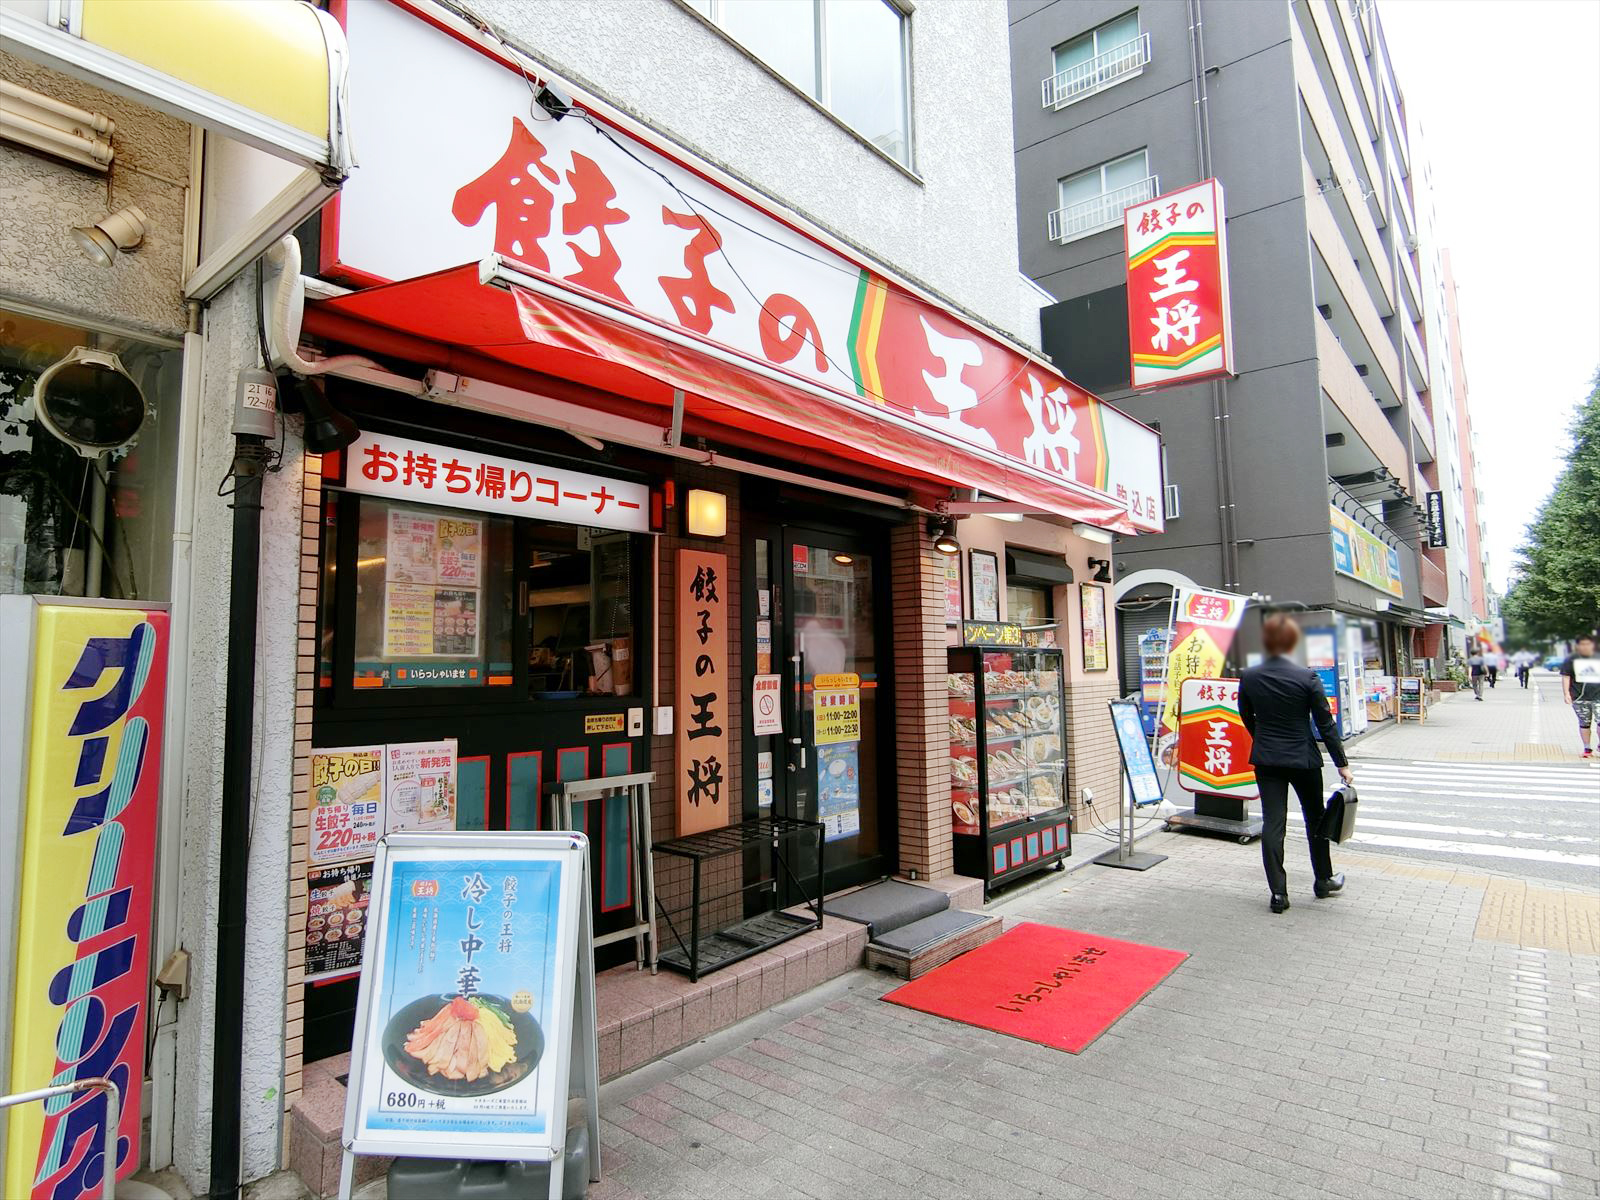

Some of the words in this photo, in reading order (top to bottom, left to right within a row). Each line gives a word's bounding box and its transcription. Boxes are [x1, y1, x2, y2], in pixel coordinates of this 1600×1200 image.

[1136, 202, 1205, 236] 餃子の
[452, 116, 829, 374] 餃子の
[912, 314, 1081, 481] 王将
[1149, 250, 1201, 352] 王将
[362, 443, 641, 515] お持ち帰りコーナー
[1192, 604, 1225, 620] 王将
[411, 669, 466, 679] いらっしゃいませ
[687, 564, 724, 808] 餃子の王将
[420, 756, 451, 769] 新発売
[1204, 720, 1232, 775] 王将
[312, 755, 381, 788] 餃子の日!!
[315, 813, 351, 831] 生餃子
[352, 802, 377, 815] 毎日
[316, 827, 377, 851] 220円+税
[33, 621, 156, 1200] クリーニング
[416, 886, 435, 896] 王将
[457, 872, 491, 999] 冷し中華
[498, 876, 517, 954] 餃子の王将
[995, 947, 1108, 1013] いらっしゃいませ
